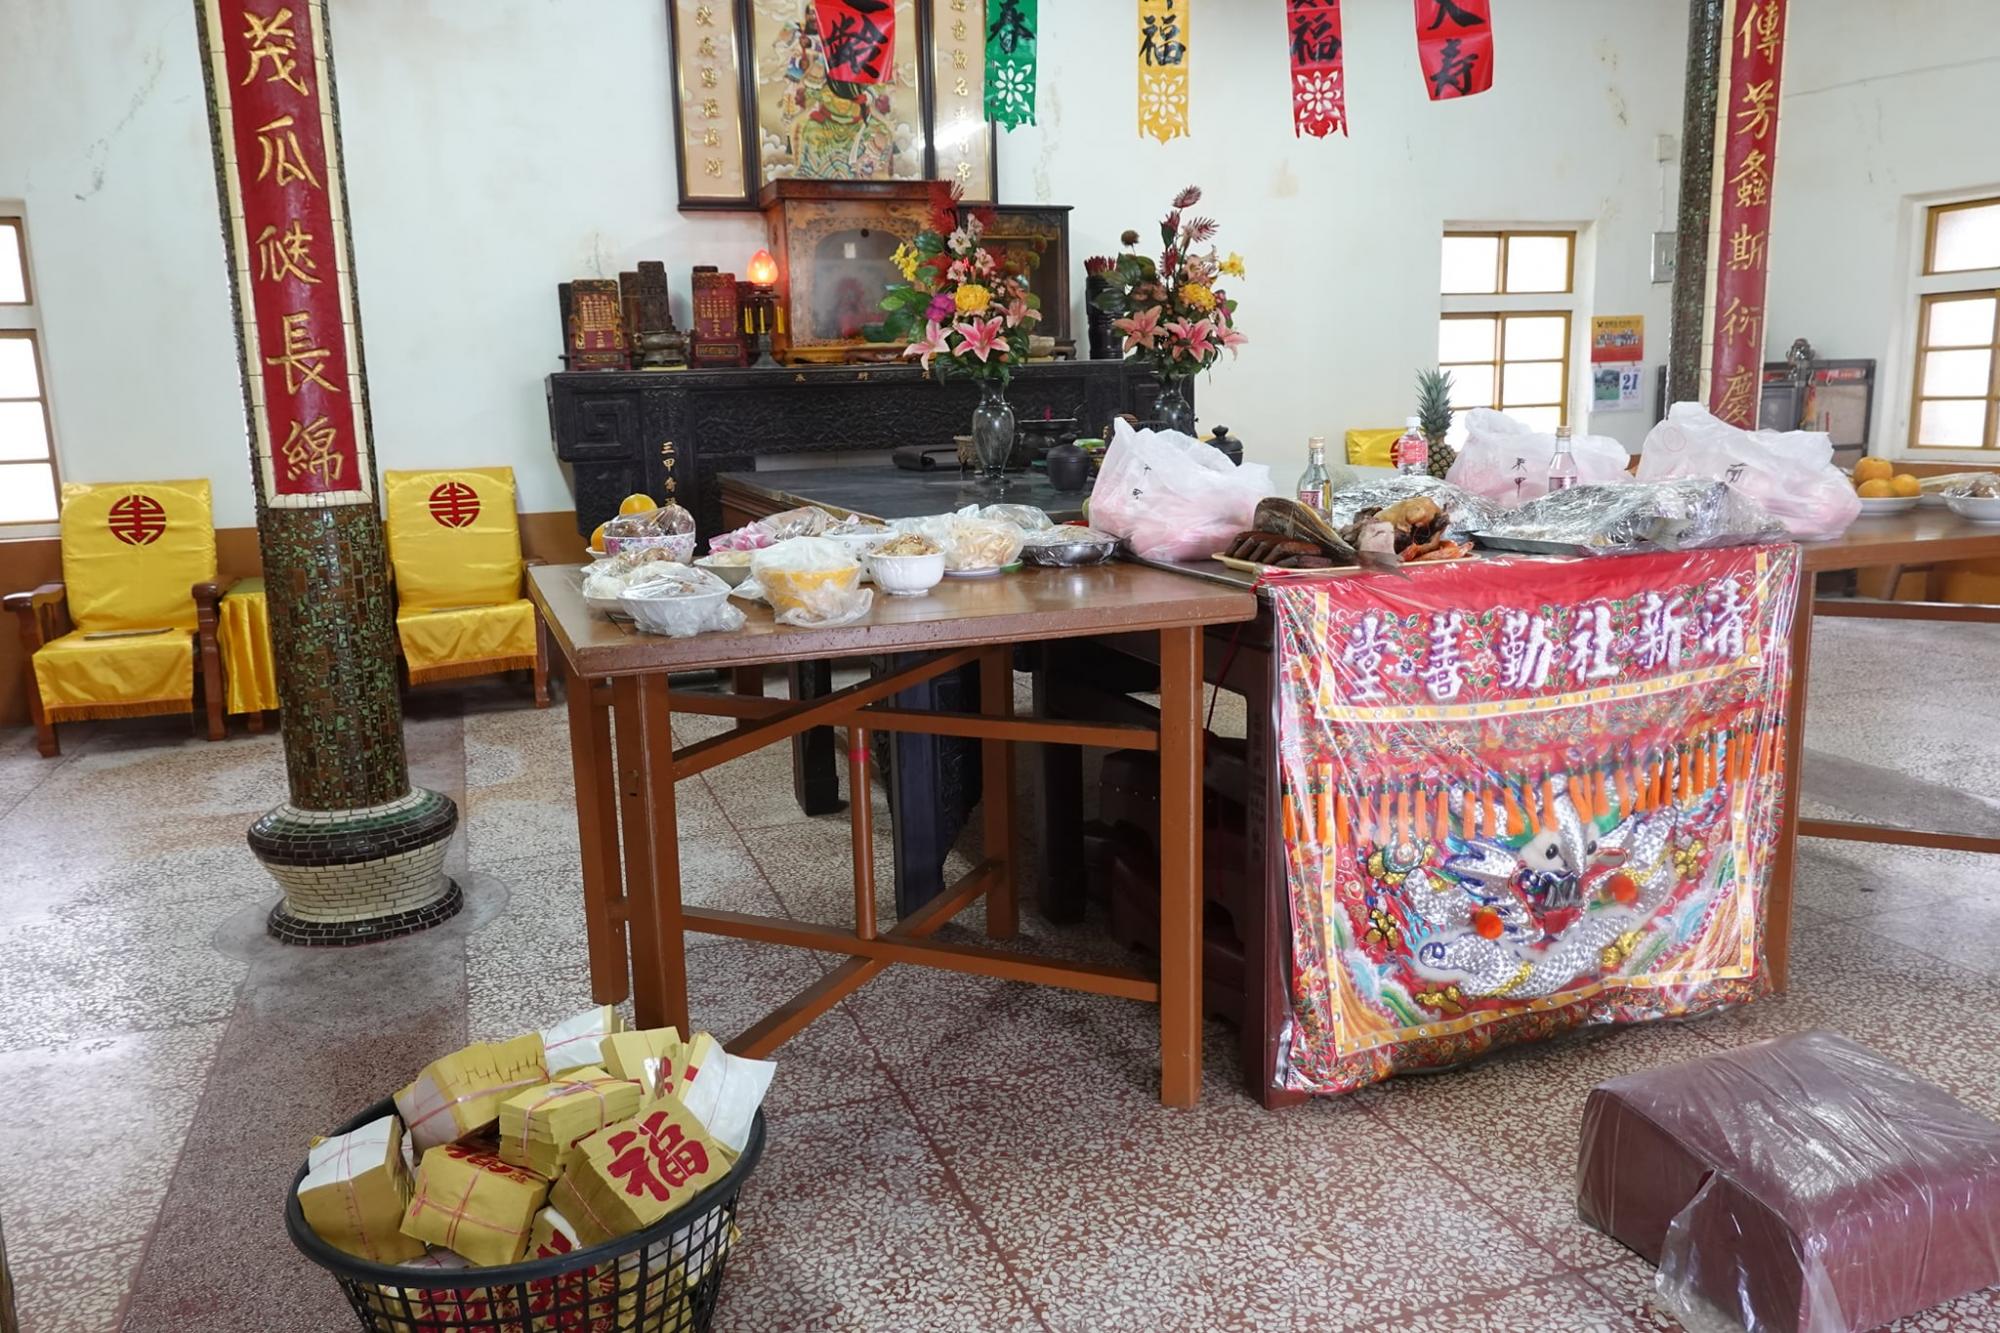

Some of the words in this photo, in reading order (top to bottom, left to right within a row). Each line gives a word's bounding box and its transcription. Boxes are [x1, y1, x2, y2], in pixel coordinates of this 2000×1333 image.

[825, 0, 889, 79] 齡
[1139, 0, 1186, 67] 福
[1292, 0, 1341, 66] 福
[1622, 373, 1638, 390] 21
[607, 1110, 709, 1202] 福
